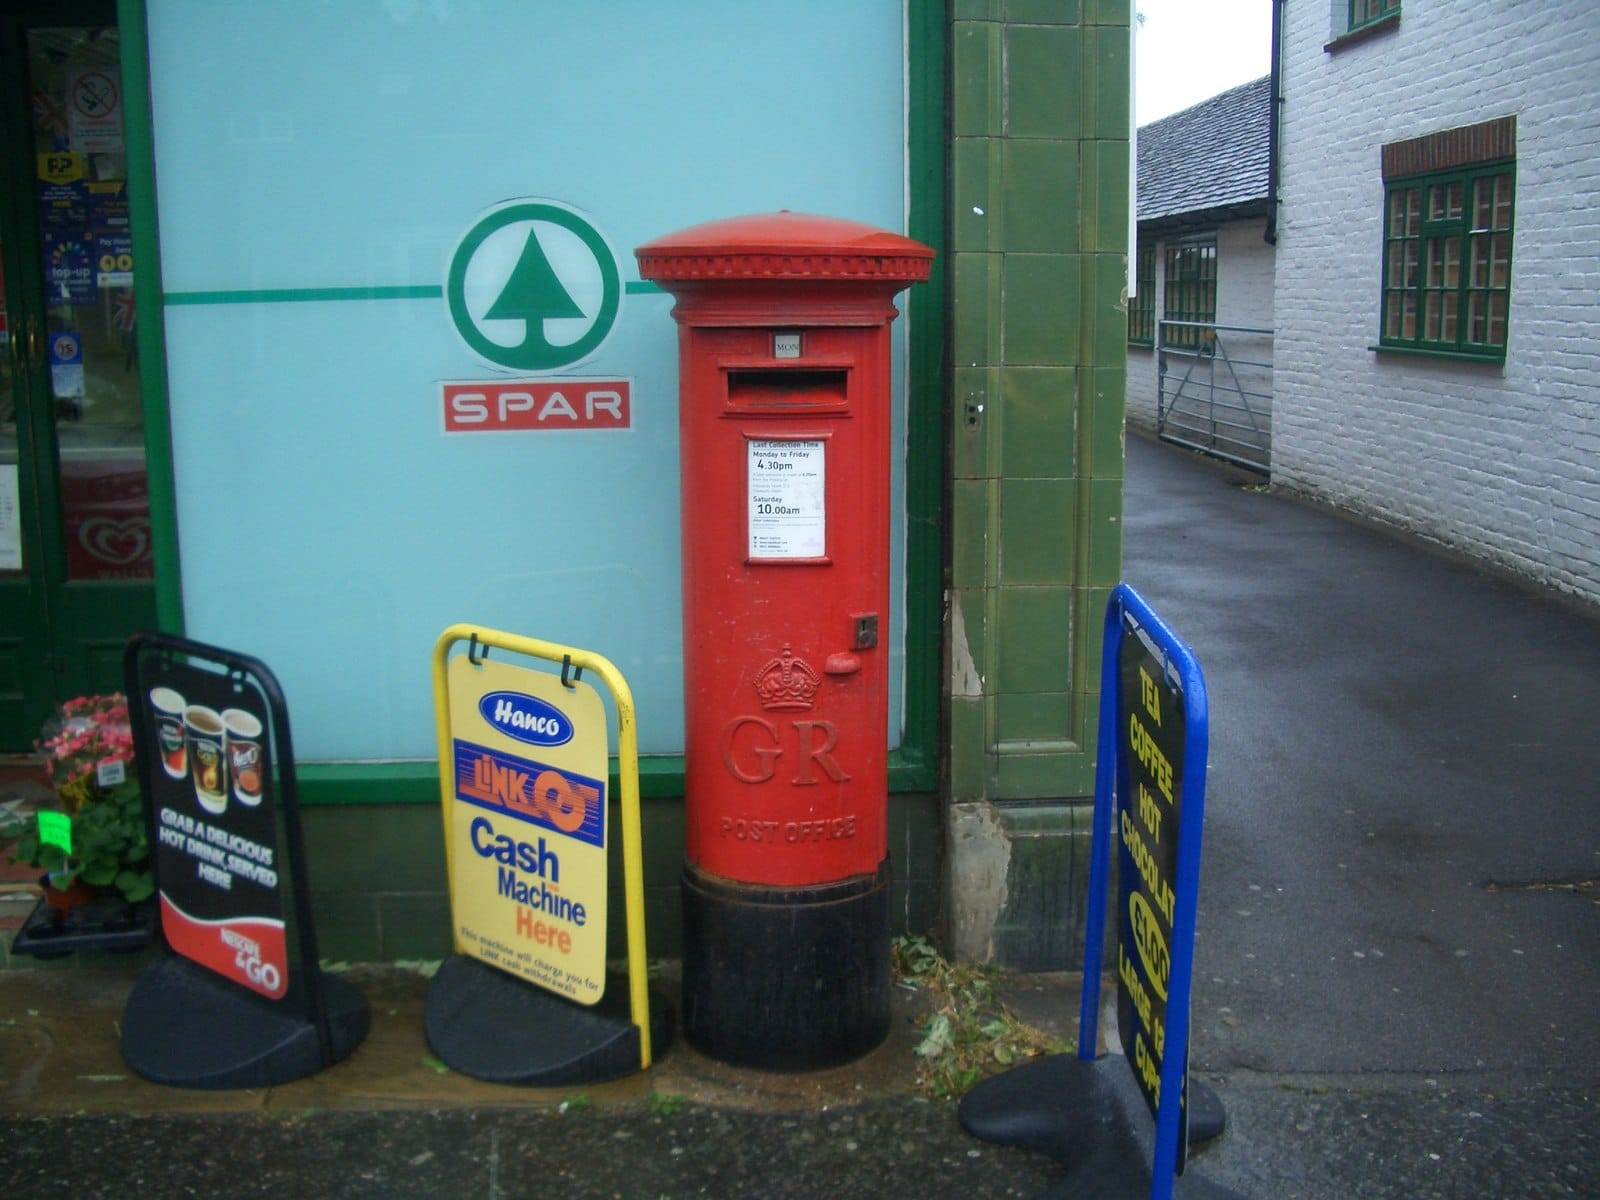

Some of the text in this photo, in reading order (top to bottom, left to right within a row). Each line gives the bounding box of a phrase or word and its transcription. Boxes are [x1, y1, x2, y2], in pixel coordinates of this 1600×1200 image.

[776, 343, 800, 351] MON
[452, 390, 622, 423] SPAR
[757, 459, 793, 471] 4.30pm
[752, 496, 782, 504] Saturday
[757, 503, 800, 514] 10.00am
[494, 699, 559, 736] Hanco
[1139, 665, 1161, 728] TEA
[1130, 713, 1174, 805] COFFEE
[160, 807, 273, 866] GRAB A DELICIOUS
[720, 815, 856, 843] POST OFFICE
[1139, 782, 1162, 844] HOT
[160, 826, 186, 850] HOT
[470, 817, 559, 883] Cash
[198, 861, 233, 891] HERE
[1121, 809, 1176, 929] CHOCOLAT
[498, 867, 586, 926] Machine
[516, 906, 572, 954] Here
[461, 927, 598, 992] This machine will charge you for
[480, 947, 576, 995] LINK cash withdrawals
[1119, 943, 1151, 1033] LARGE
